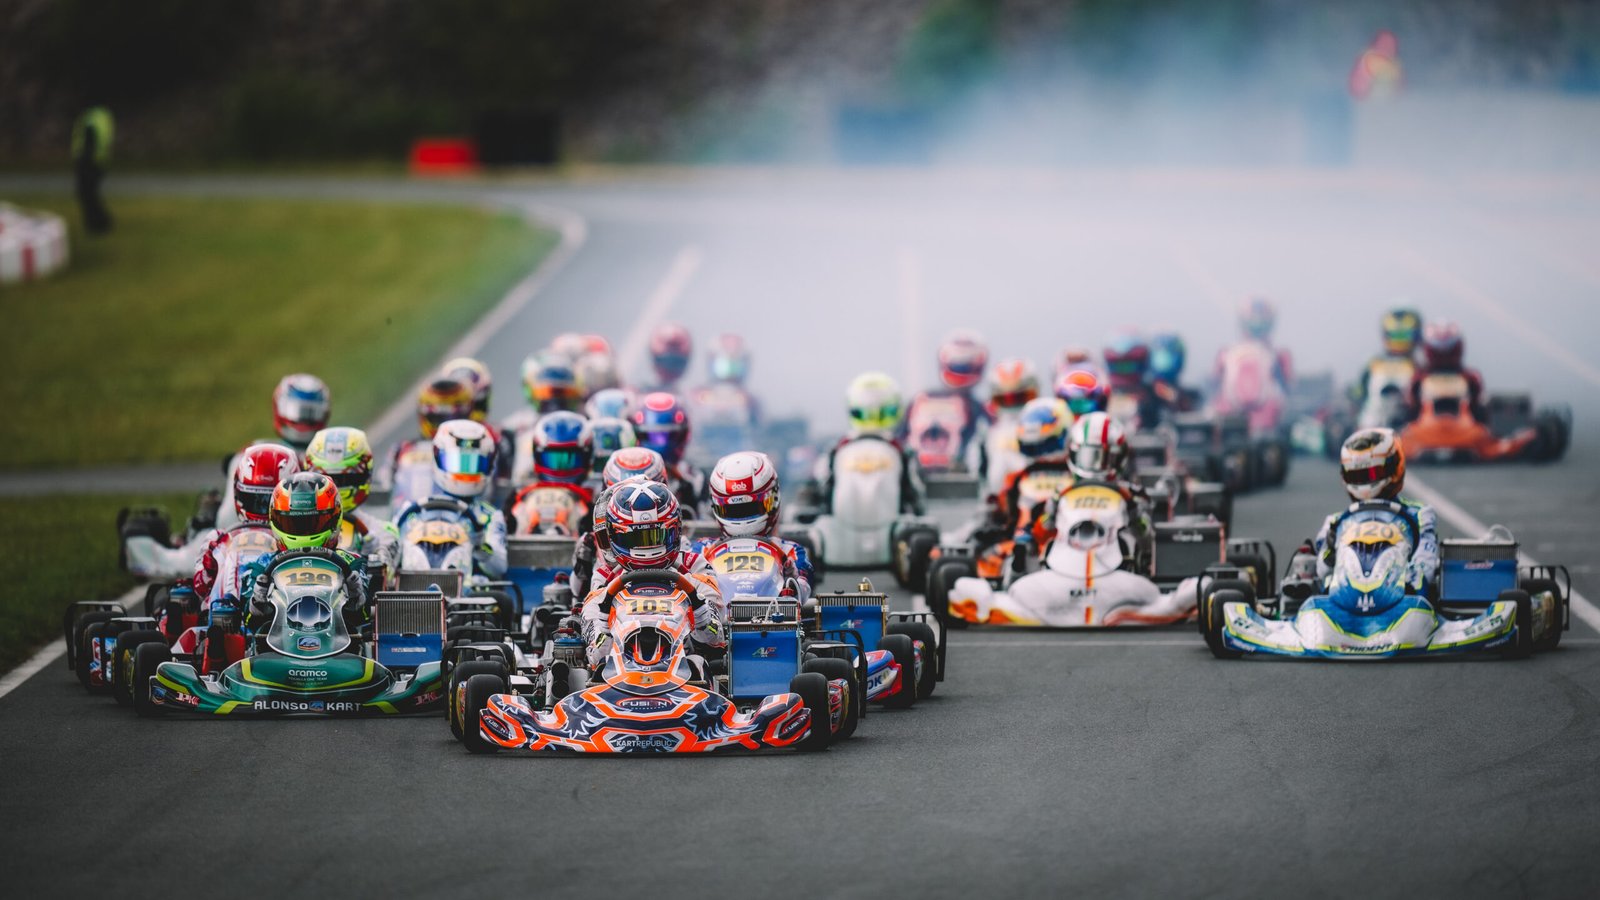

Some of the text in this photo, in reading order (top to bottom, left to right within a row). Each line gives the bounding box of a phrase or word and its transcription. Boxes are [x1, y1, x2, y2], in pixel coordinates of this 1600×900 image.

[723, 555, 765, 573] 123
[286, 572, 333, 585] 139
[288, 669, 328, 677] aramco
[254, 700, 361, 711] ALONSO KART
